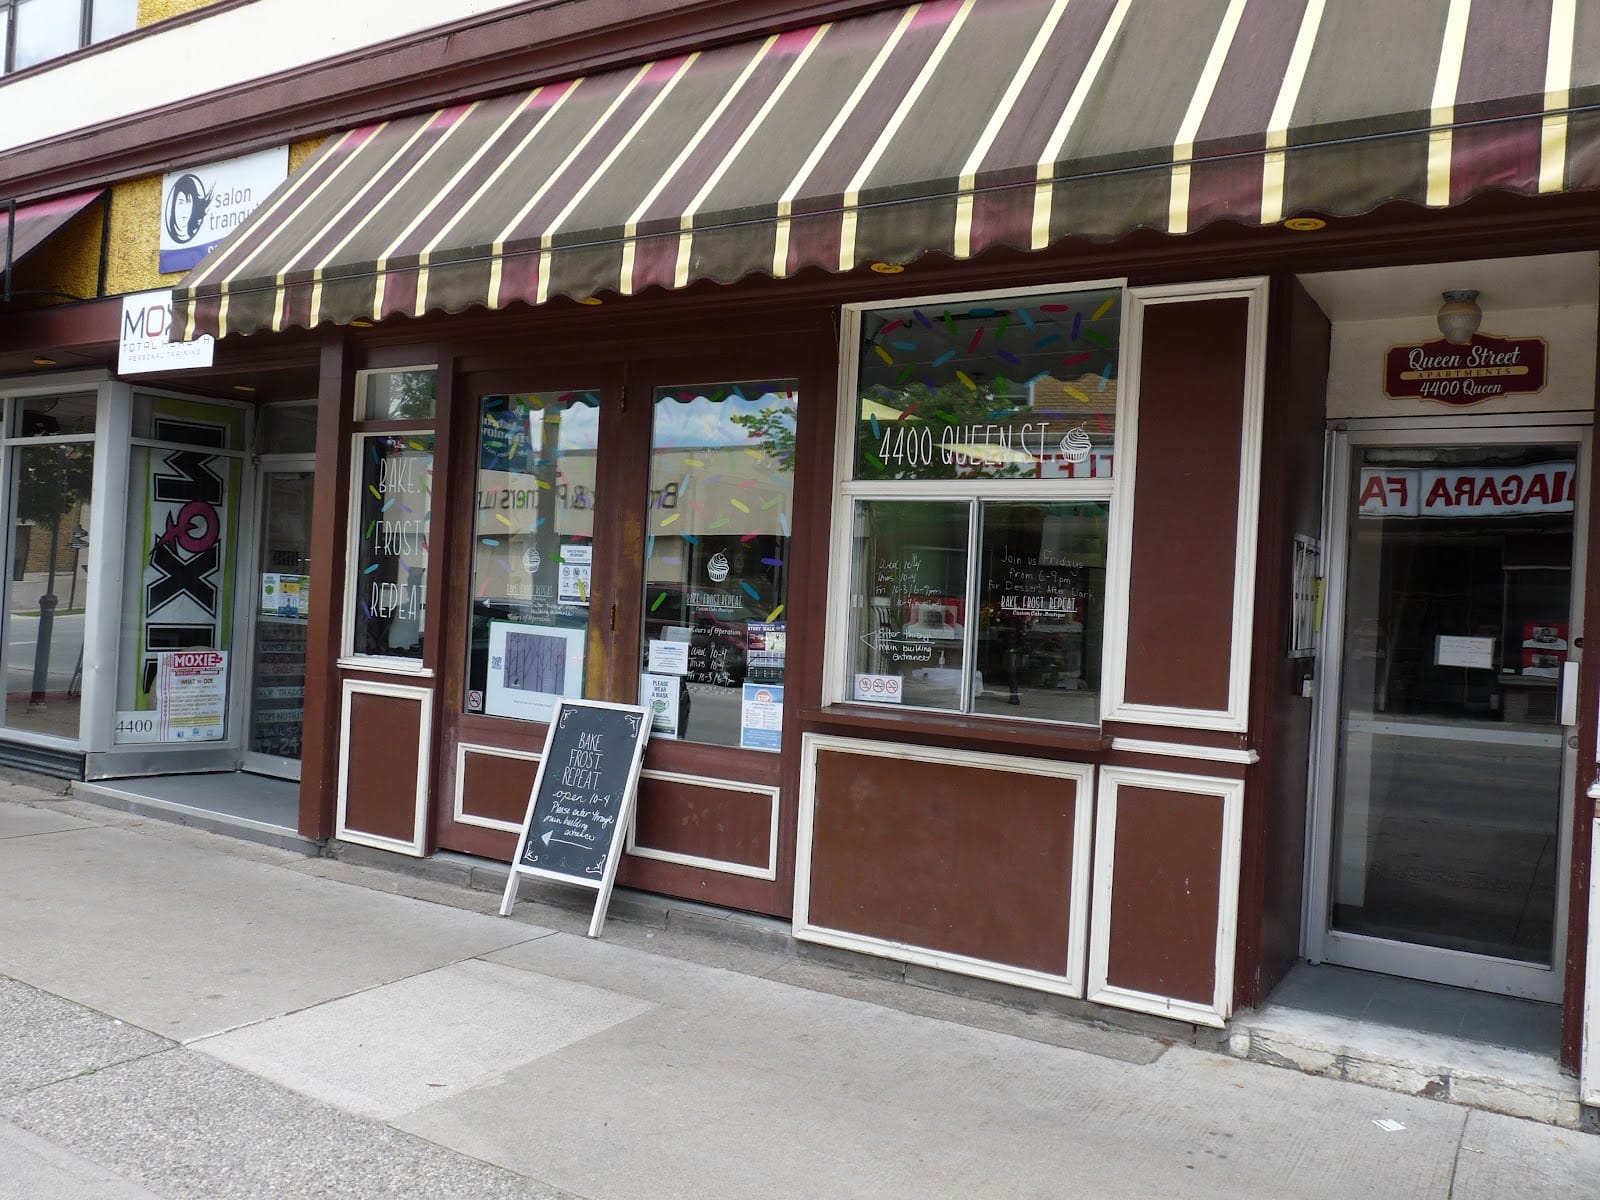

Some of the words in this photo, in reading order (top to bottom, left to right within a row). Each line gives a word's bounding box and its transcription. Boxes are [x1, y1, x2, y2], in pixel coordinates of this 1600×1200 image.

[215, 187, 252, 208] salon
[1408, 347, 1462, 370] Queen
[1466, 345, 1521, 367] Street
[1417, 367, 1512, 379] APARTMENTS
[1419, 380, 1460, 396] 4400
[1462, 378, 1502, 395] Queen
[878, 426, 933, 465] 4400
[941, 424, 1012, 466] QUEEN
[142, 417, 226, 694] MOXI
[1001, 545, 1022, 565] Join
[1028, 557, 1037, 566] us
[1043, 549, 1083, 576] Fridays
[1009, 568, 1034, 580] from
[1005, 581, 1042, 594] Dessert
[707, 627, 714, 636] of
[714, 628, 741, 637] Operation
[174, 653, 217, 669] MOXIE
[115, 719, 153, 734] 4400
[552, 790, 587, 804] open
[589, 793, 611, 807] 10-4
[551, 801, 571, 815] Please
